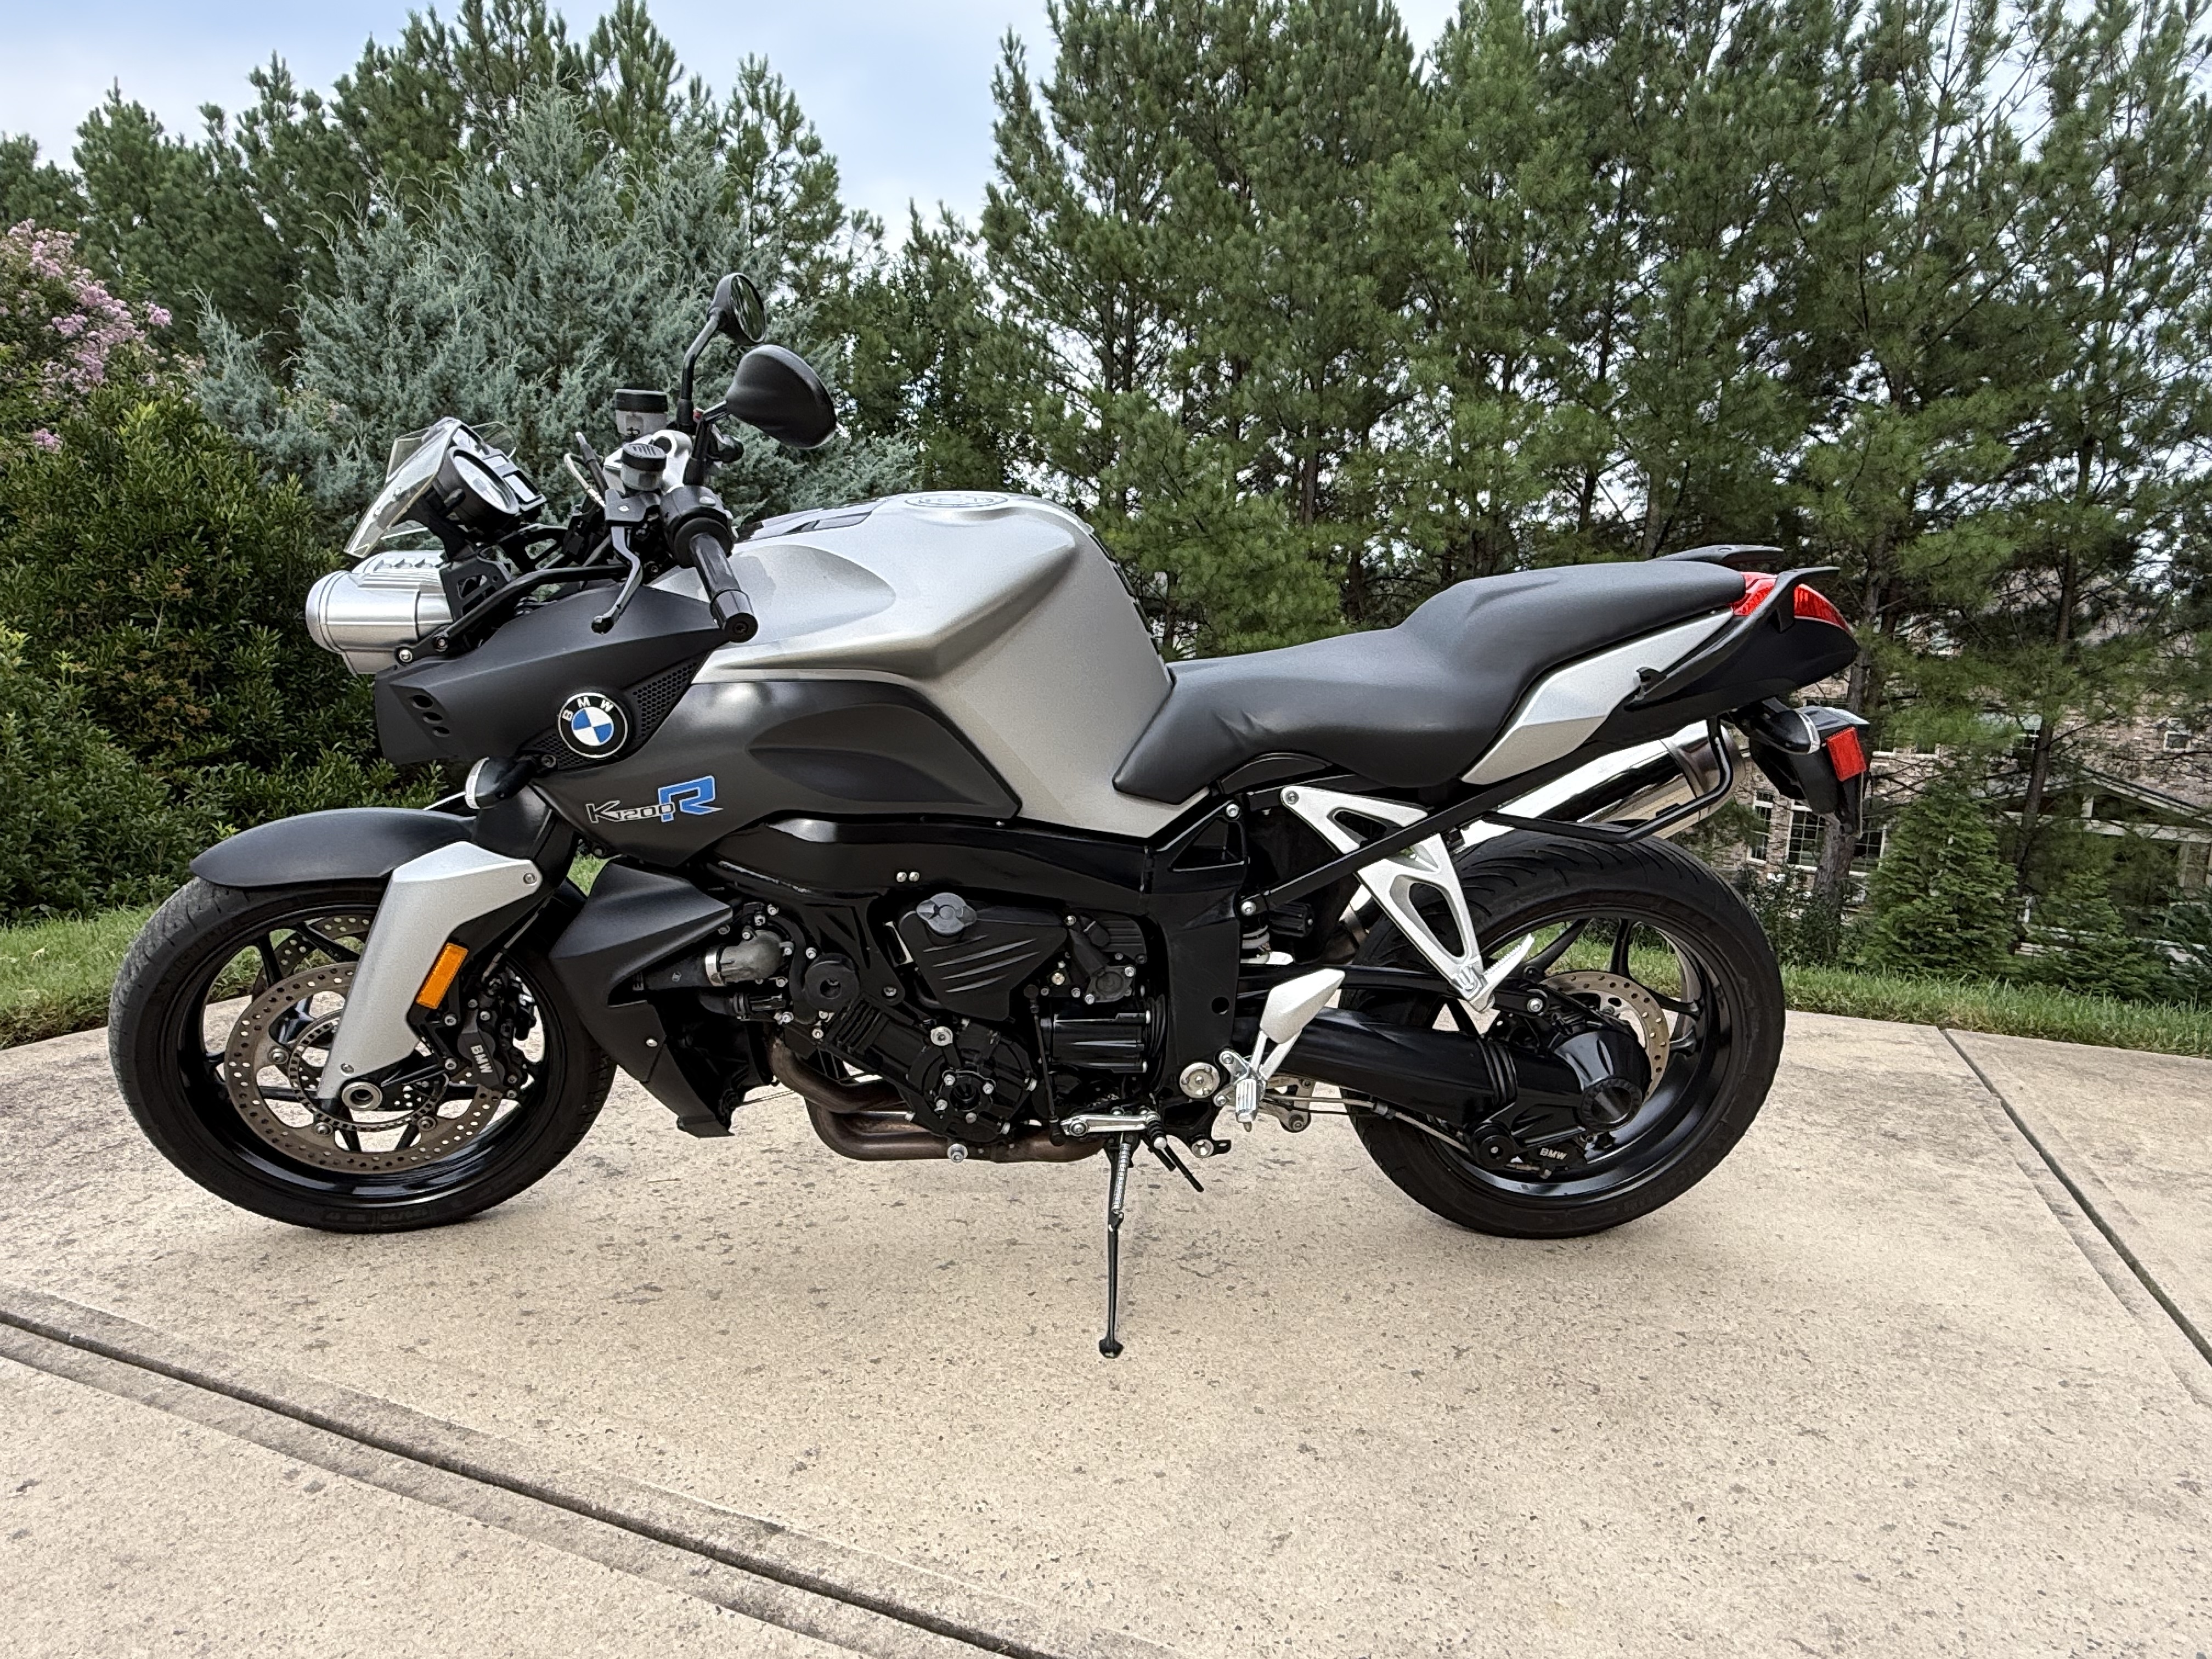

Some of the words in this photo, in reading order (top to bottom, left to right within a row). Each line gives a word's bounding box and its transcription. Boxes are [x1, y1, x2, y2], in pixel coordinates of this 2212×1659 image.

[561, 696, 614, 722] BMW
[471, 1045, 493, 1073] BMW
[1539, 1148, 1567, 1160] BMW
